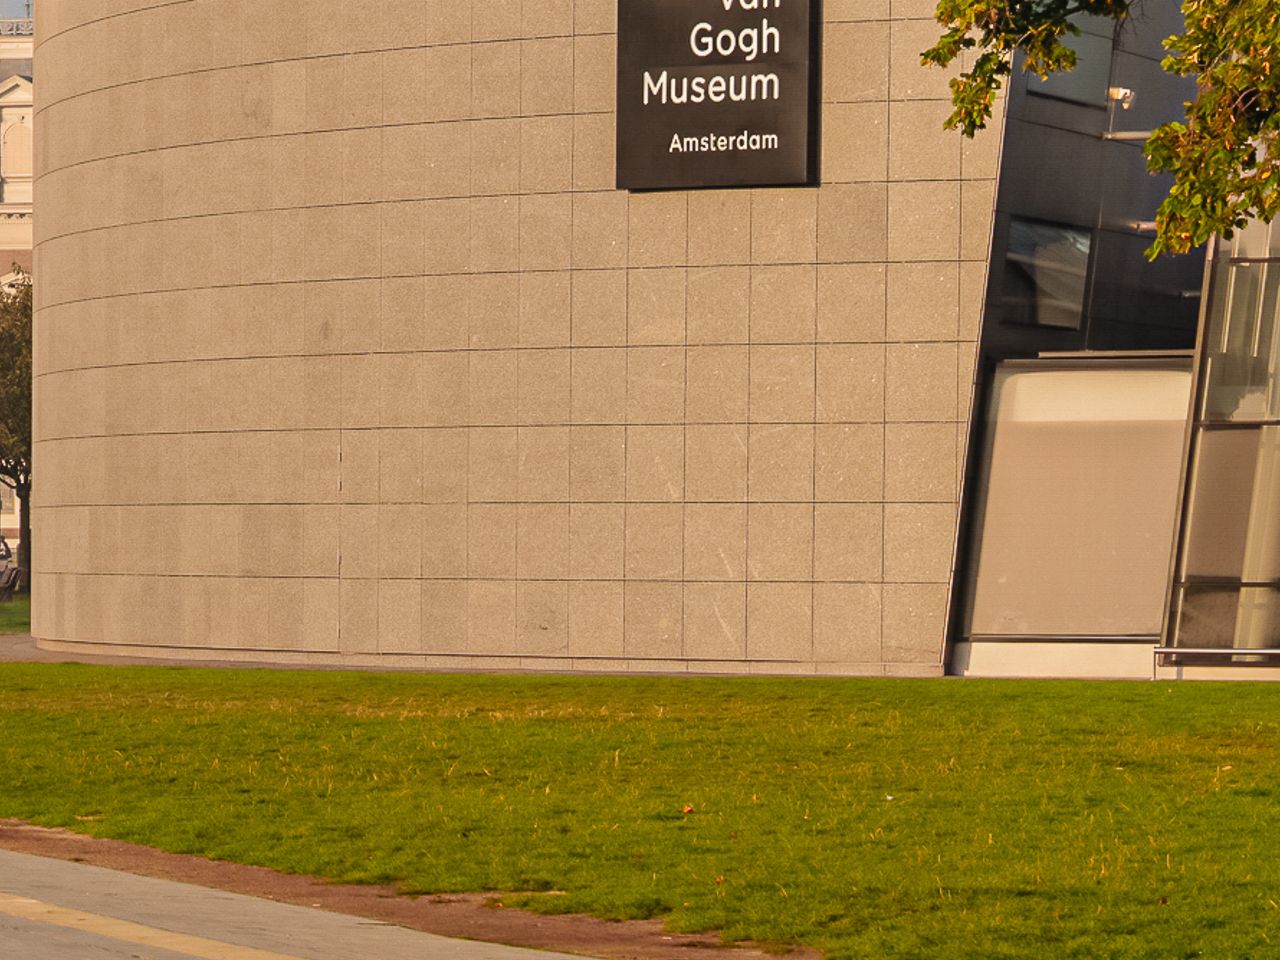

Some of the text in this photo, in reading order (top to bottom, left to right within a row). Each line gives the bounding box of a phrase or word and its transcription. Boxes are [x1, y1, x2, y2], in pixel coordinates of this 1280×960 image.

[690, 18, 780, 61] Gogh
[643, 70, 780, 105] Museum
[669, 130, 778, 152] Amsterdam
